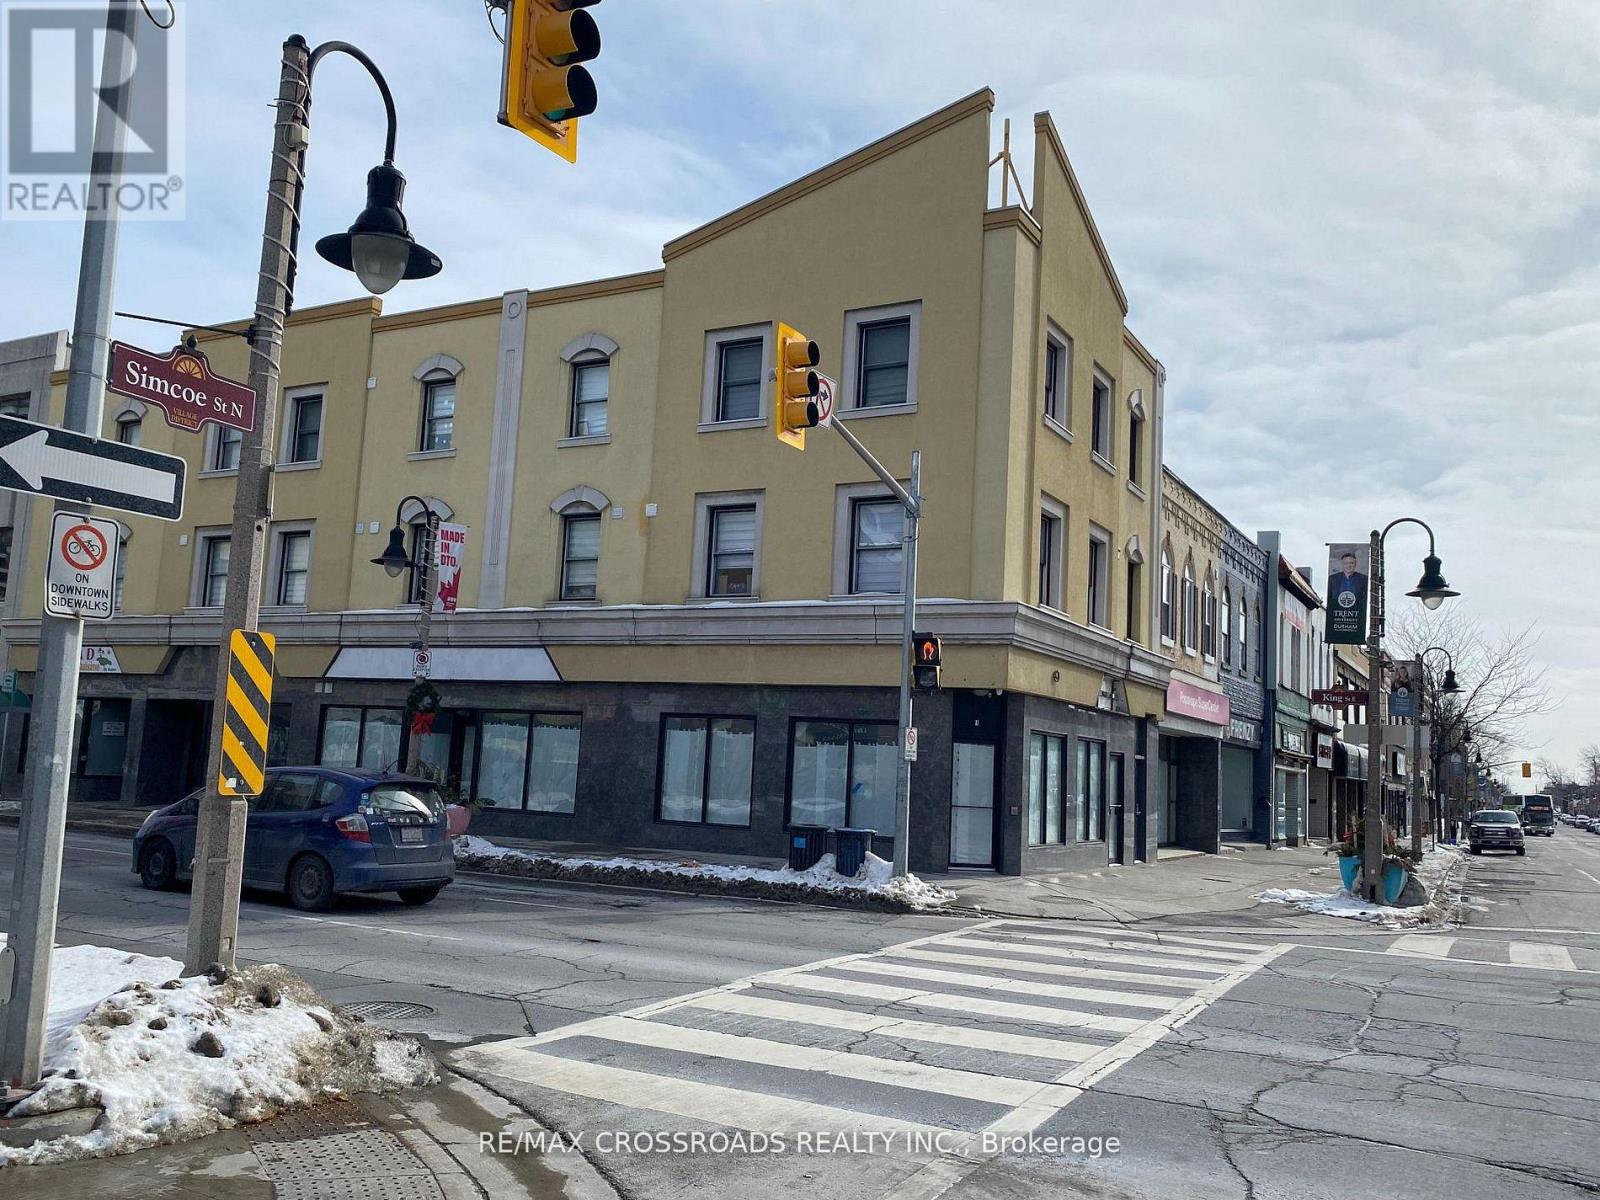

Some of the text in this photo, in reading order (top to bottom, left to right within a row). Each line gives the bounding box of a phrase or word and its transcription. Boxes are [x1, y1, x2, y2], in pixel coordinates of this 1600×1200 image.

[125, 361, 243, 418] Simcoe St N
[173, 408, 198, 420] VILLAGE
[171, 415, 199, 428] DISTRICT
[441, 529, 465, 544] MADE
[441, 542, 450, 554] IN
[75, 573, 89, 583] ON
[51, 583, 108, 598] DOWNTOWN
[51, 596, 108, 611] SIDEWALKS
[1333, 610, 1359, 618] TRENT
[1322, 693, 1343, 703] King
